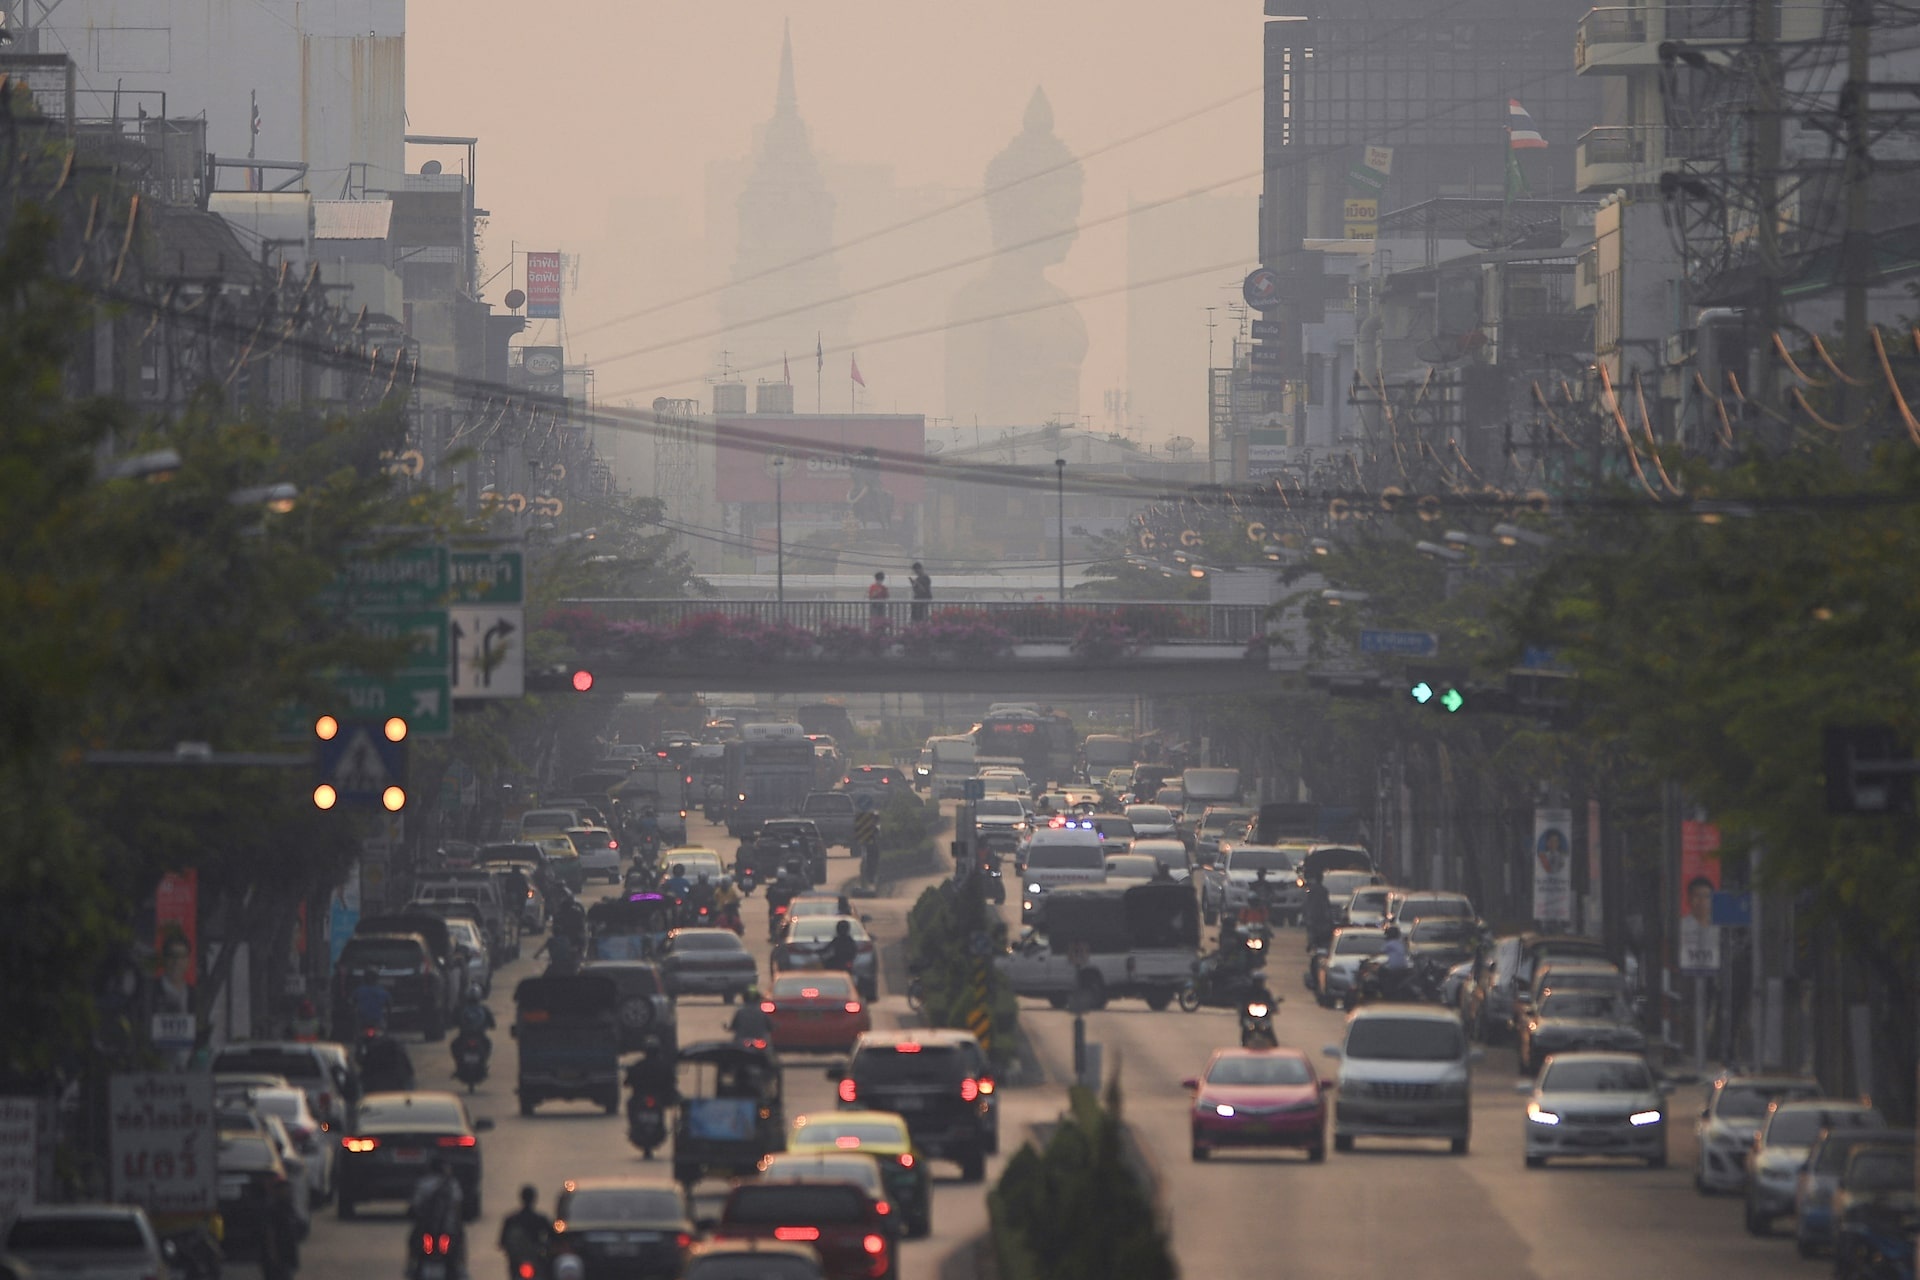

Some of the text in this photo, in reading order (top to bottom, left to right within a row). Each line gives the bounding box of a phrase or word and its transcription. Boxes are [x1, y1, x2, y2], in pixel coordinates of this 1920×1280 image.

[1345, 203, 1376, 217] เมือง
[528, 256, 559, 268] ทำฟัน
[528, 271, 559, 282] จัดฟัน
[1249, 447, 1286, 456] FamilyMart
